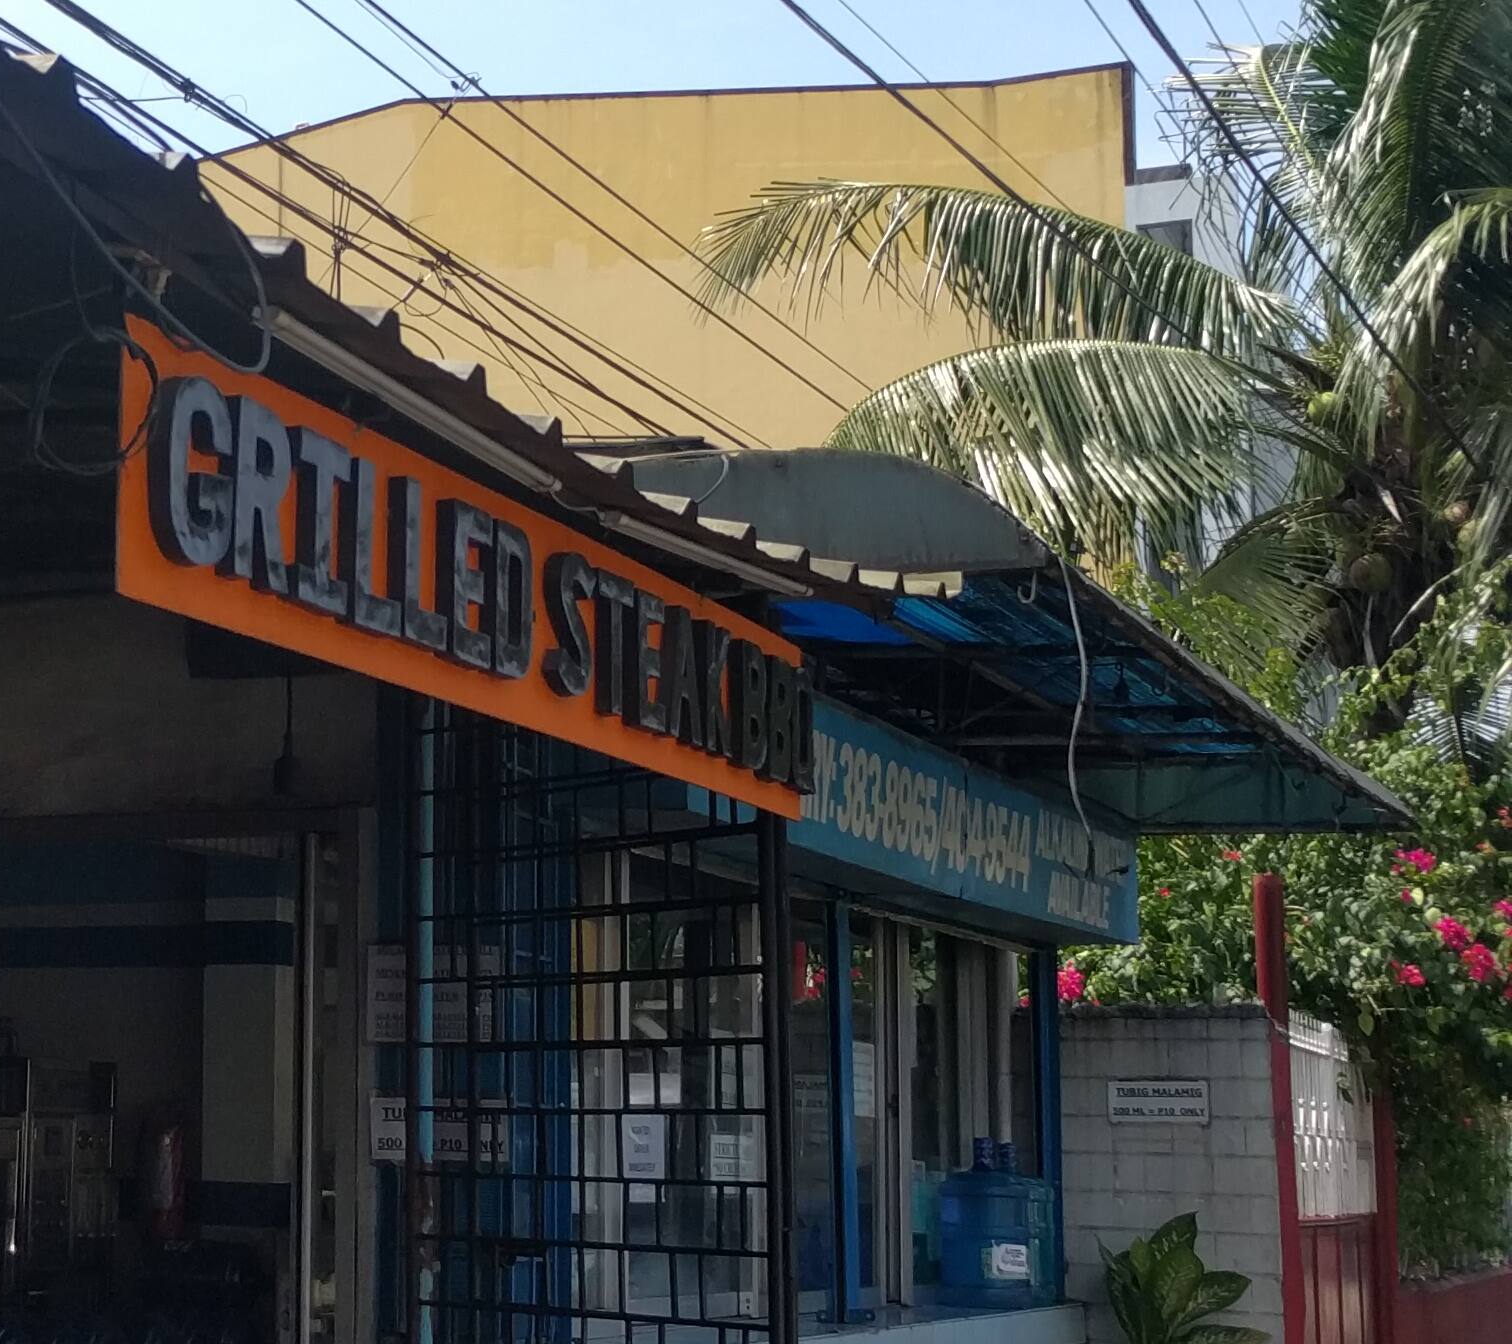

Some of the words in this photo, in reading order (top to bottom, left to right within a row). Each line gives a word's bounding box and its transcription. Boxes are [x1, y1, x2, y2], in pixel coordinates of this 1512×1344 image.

[147, 375, 535, 679] GRILLED
[540, 550, 734, 758] STEAK
[1116, 1087, 1150, 1098] TUBIG
[1152, 1087, 1203, 1098] MALAMIG
[1112, 1106, 1130, 1117] 500
[1179, 1106, 1206, 1117] ONLY
[377, 1137, 404, 1151] 500
[440, 1138, 463, 1152] P10
